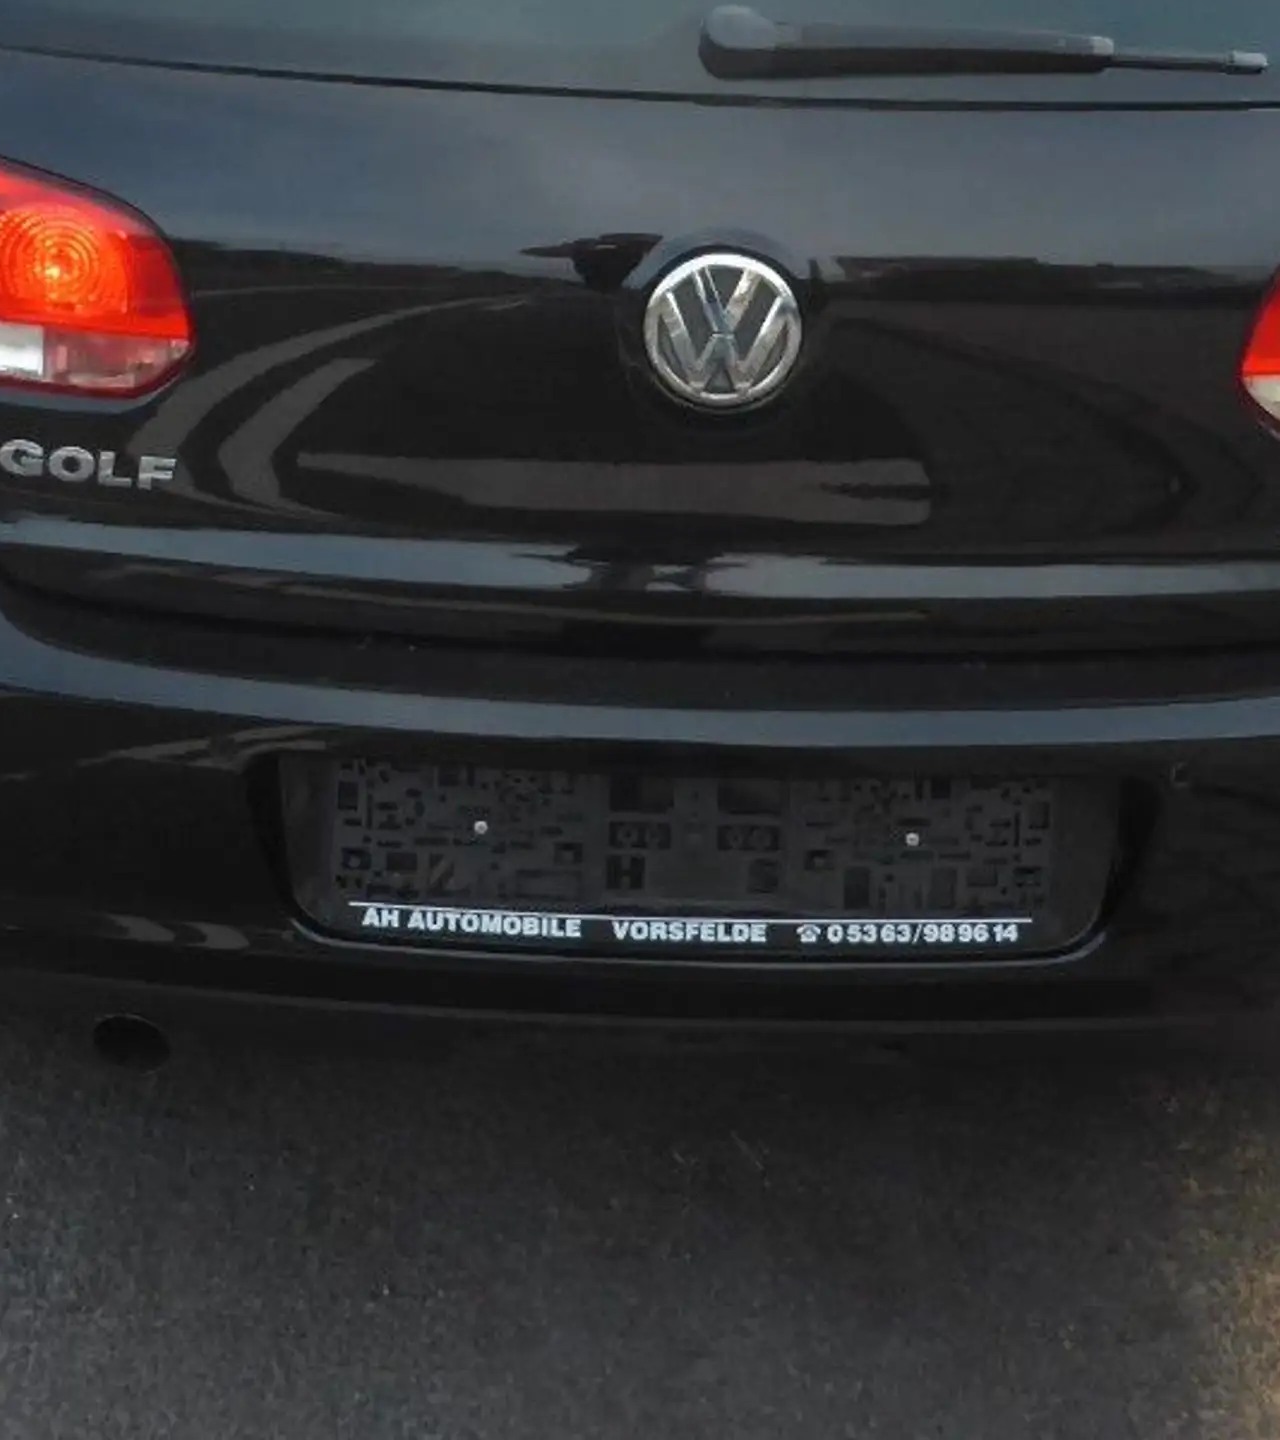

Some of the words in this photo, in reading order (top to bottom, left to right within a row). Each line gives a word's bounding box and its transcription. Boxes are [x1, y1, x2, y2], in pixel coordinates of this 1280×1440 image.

[362, 907, 400, 928] AH
[408, 911, 581, 938] AUTOMOBILE
[613, 922, 767, 942] VORSFELDE
